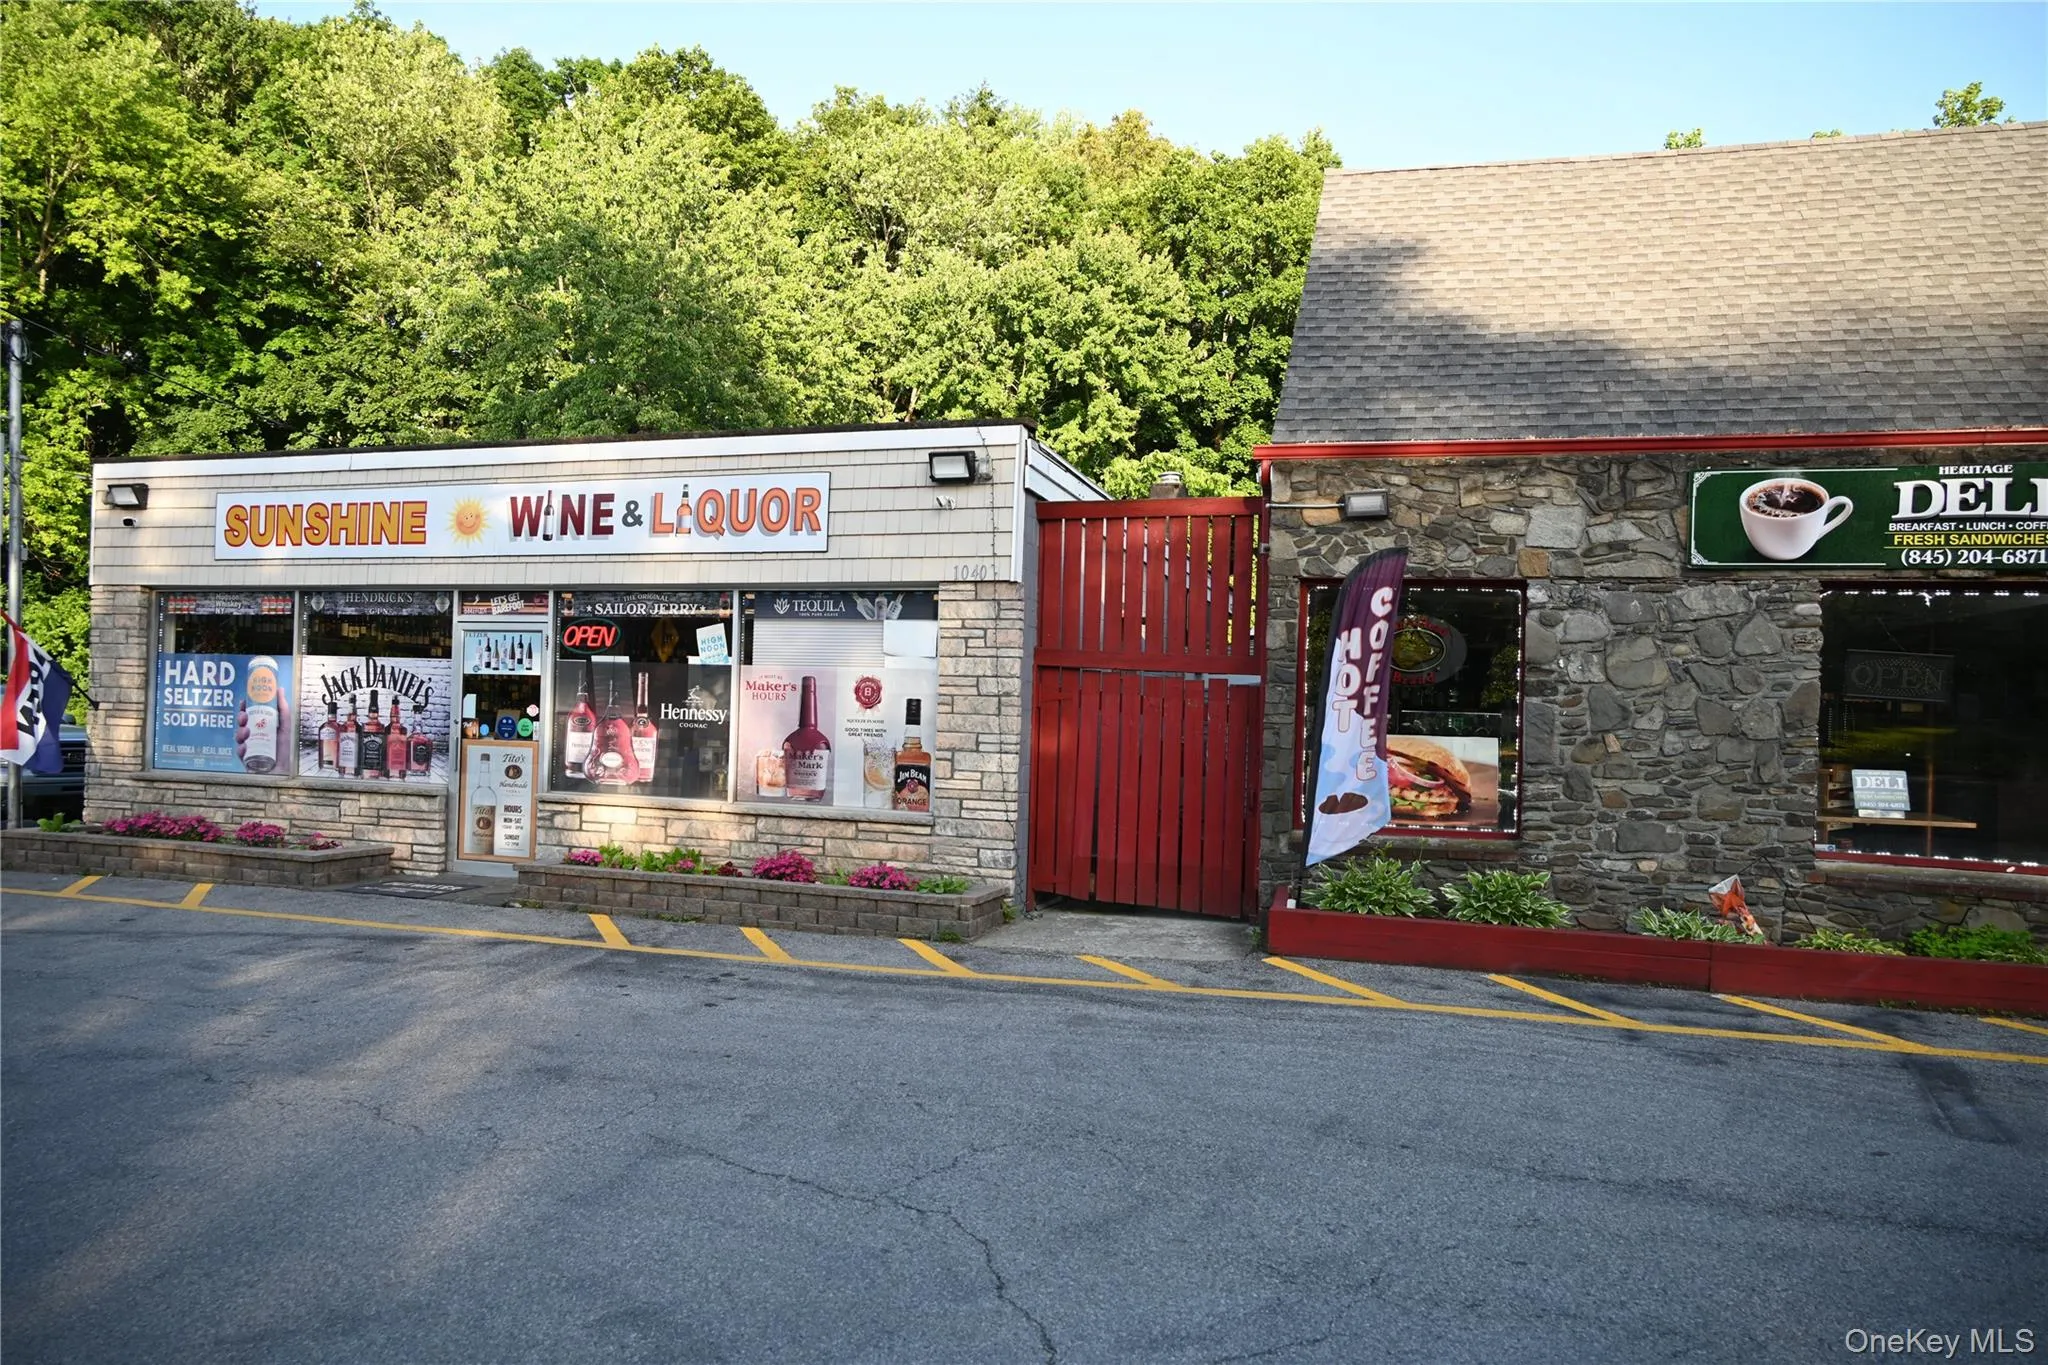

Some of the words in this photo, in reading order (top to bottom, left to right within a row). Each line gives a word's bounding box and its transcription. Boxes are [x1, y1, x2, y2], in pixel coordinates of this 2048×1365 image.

[1938, 464, 2014, 475] HERITAGE
[621, 500, 643, 527] &
[224, 500, 428, 548] SUNSHINE
[1888, 522, 1957, 531] BREAKFAST
[1966, 521, 2006, 531] LUNCH
[2015, 521, 2048, 530] COFF
[1893, 534, 1945, 546] FRESH
[1900, 547, 1952, 567] (845)
[1957, 549, 2048, 565] 204-6871
[953, 564, 988, 581] 1040
[345, 592, 413, 603] HENDRICK'S
[490, 594, 507, 606] LET'S
[507, 592, 520, 602] GET
[491, 599, 525, 615] BAREFOOT
[594, 603, 647, 615] SAILOR
[649, 603, 698, 615] JERRY
[792, 599, 846, 612] TEQUILA
[563, 625, 617, 648] OPEN
[701, 635, 723, 646] HIGH
[700, 643, 725, 653] NOON
[164, 660, 236, 687] HARD
[1331, 626, 1363, 734] HOT
[1850, 661, 1946, 692] OPEN
[321, 664, 363, 706] JACK
[365, 657, 435, 713] DANIEL'S
[745, 680, 798, 692] Maker's
[1356, 586, 1394, 782] COFFEE
[163, 687, 235, 707] SELTZER
[752, 692, 787, 701] HOURS
[163, 712, 197, 727] SOLD
[200, 713, 234, 729] HERE
[660, 702, 728, 725] Hennessy
[502, 753, 525, 763] Tito's
[797, 760, 824, 769] Mark
[910, 769, 927, 784] BEAM
[1855, 776, 1905, 790] DELI
[896, 797, 927, 806] ORANGE
[503, 804, 523, 814] HOURS
